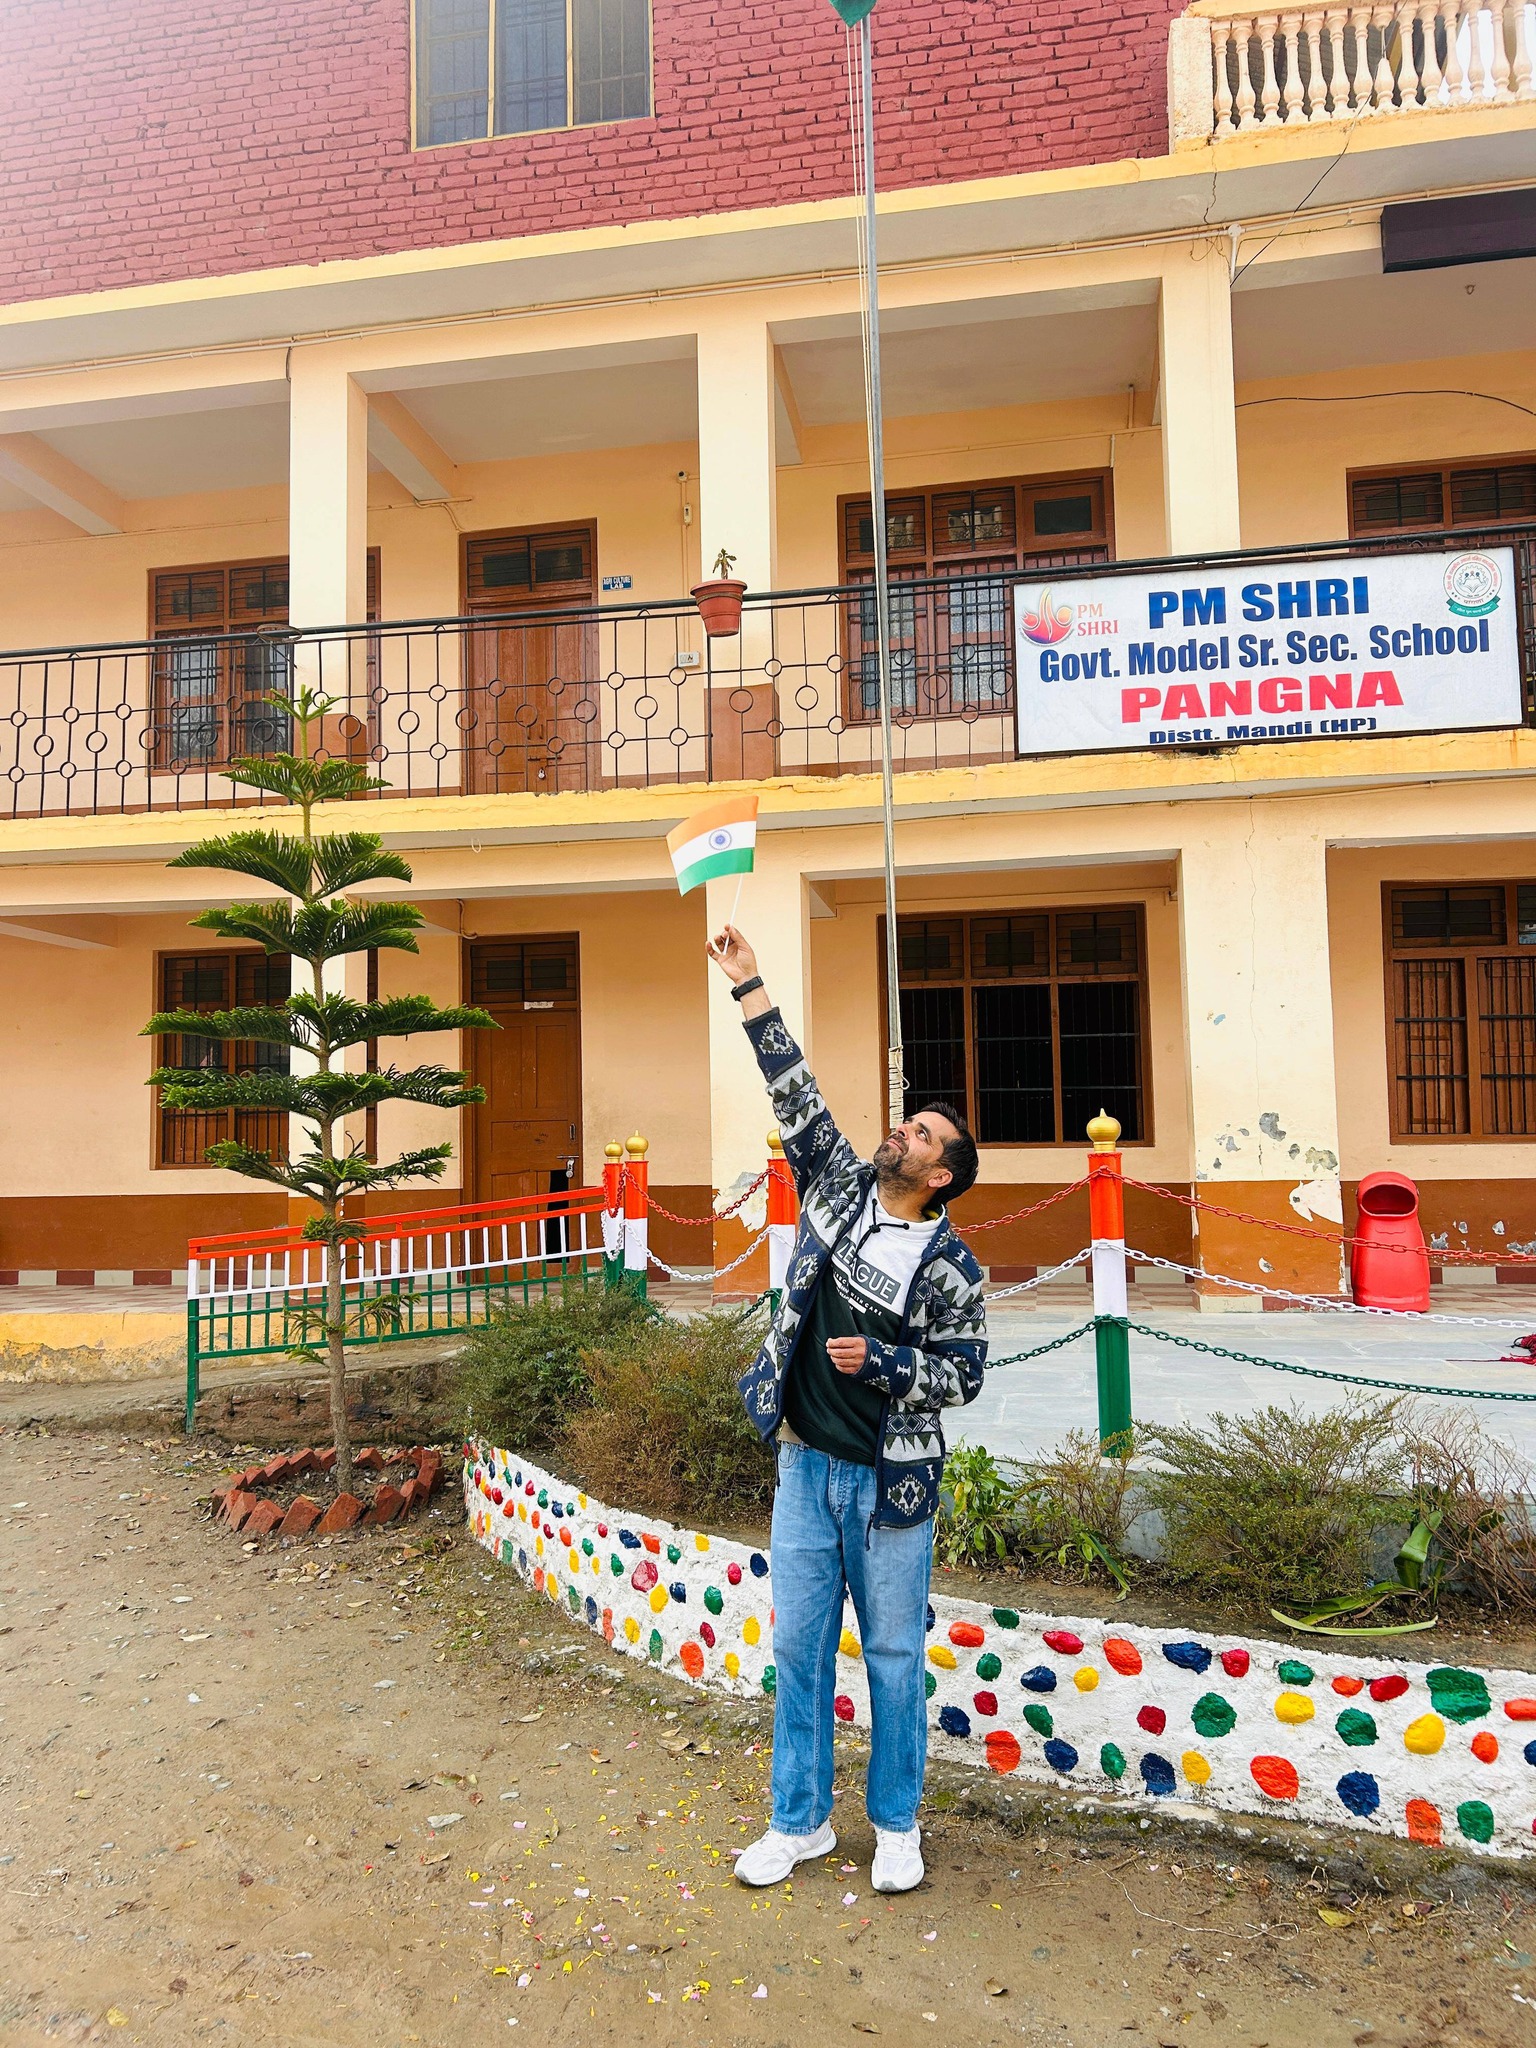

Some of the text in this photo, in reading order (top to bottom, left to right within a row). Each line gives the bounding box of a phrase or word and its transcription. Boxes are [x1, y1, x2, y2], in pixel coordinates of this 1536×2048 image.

[1077, 603, 1103, 619] PM
[1148, 576, 1369, 629] PM SHRI
[1077, 620, 1119, 636] SHRI
[1039, 619, 1490, 682] Govt. Model Sr. Sec. School
[1121, 671, 1404, 723] PANGNA
[1150, 729, 1220, 744] Distt.
[1227, 721, 1312, 739] Mandi
[837, 1243, 896, 1299] LEAGUE
[865, 1302, 882, 1316] CARE
